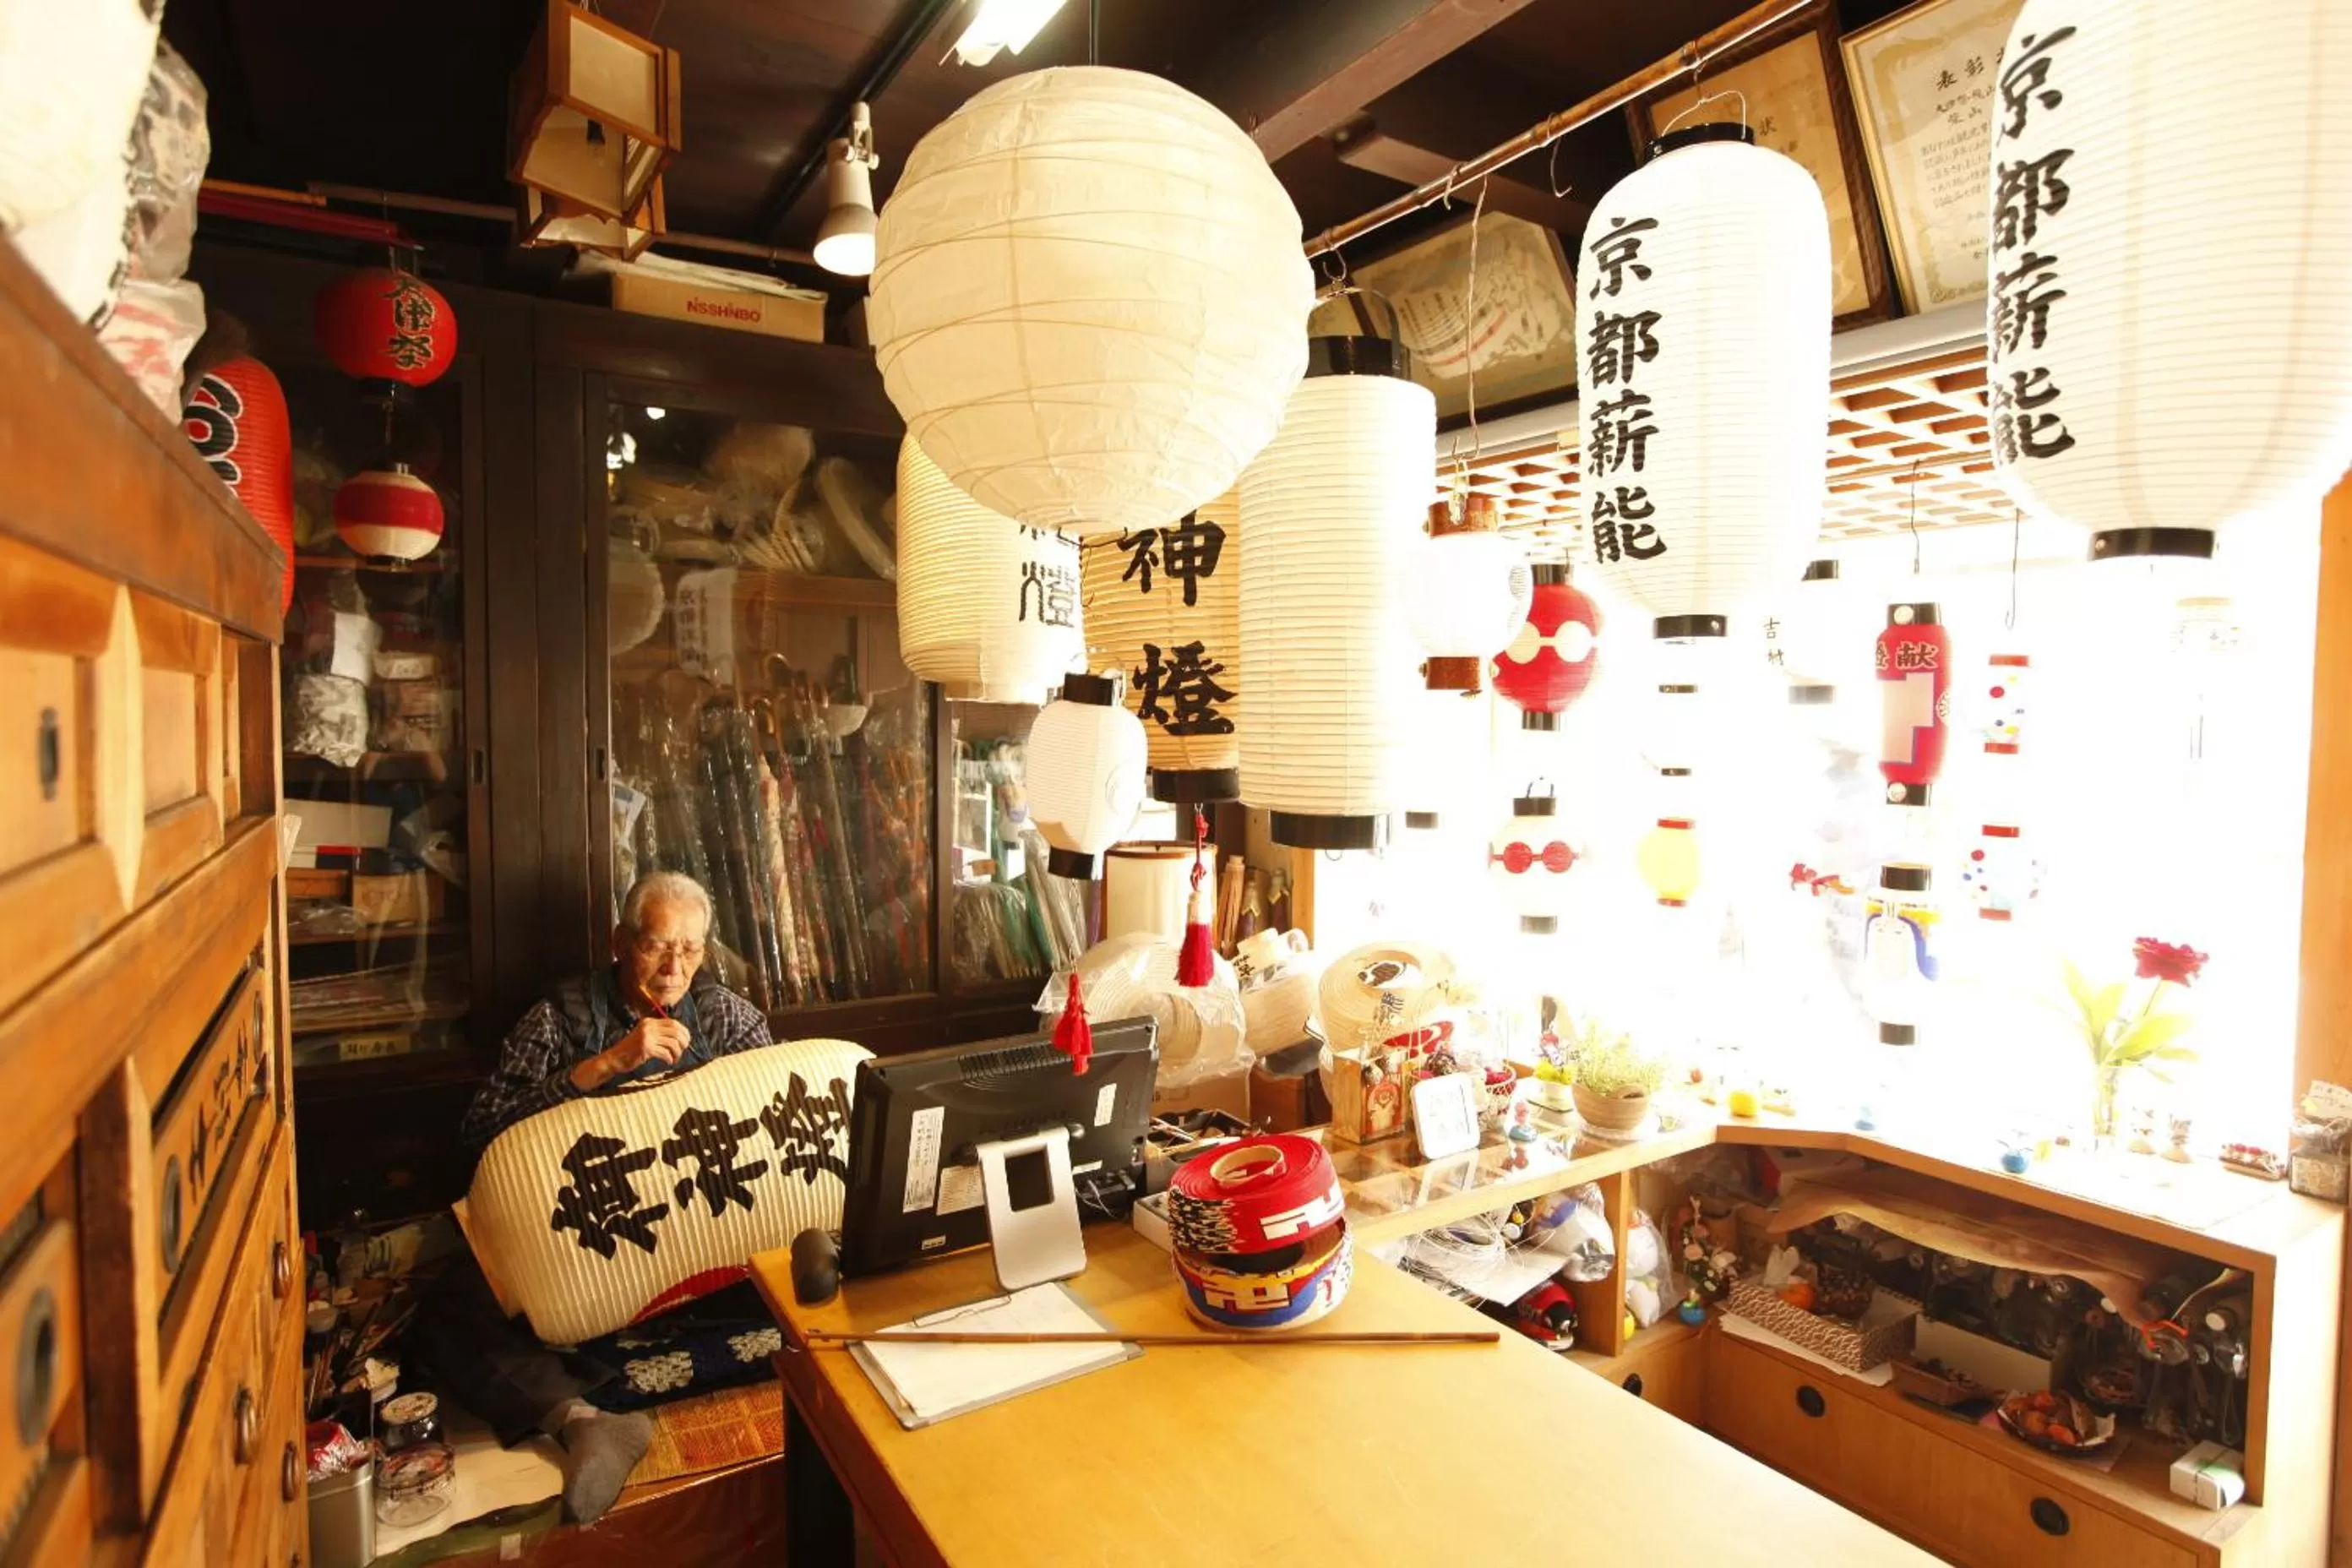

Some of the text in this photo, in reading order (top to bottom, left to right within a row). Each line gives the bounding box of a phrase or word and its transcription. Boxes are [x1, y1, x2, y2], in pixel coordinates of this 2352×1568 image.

[1993, 26, 2077, 464] 京都薪能
[1585, 216, 1669, 564] 京都薪能
[1117, 509, 1239, 737] 神燈
[551, 1070, 853, 1260] 御神燈
